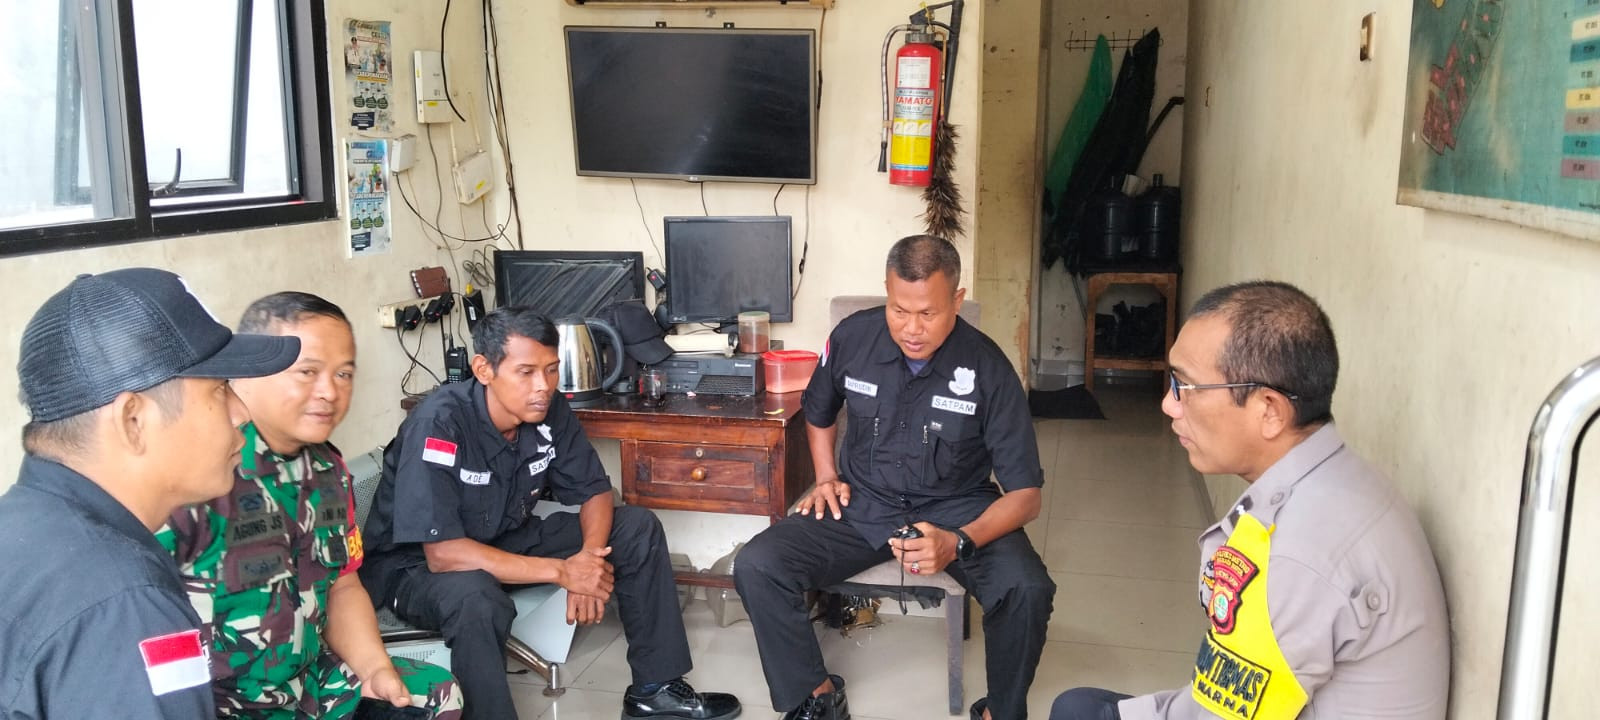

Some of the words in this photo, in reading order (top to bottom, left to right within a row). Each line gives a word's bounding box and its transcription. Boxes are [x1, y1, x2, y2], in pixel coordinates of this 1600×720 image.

[895, 95, 932, 105] YAMATO
[934, 398, 974, 414] SATPAM
[233, 518, 268, 541] AGUNG
[1197, 679, 1249, 718] WARNA
